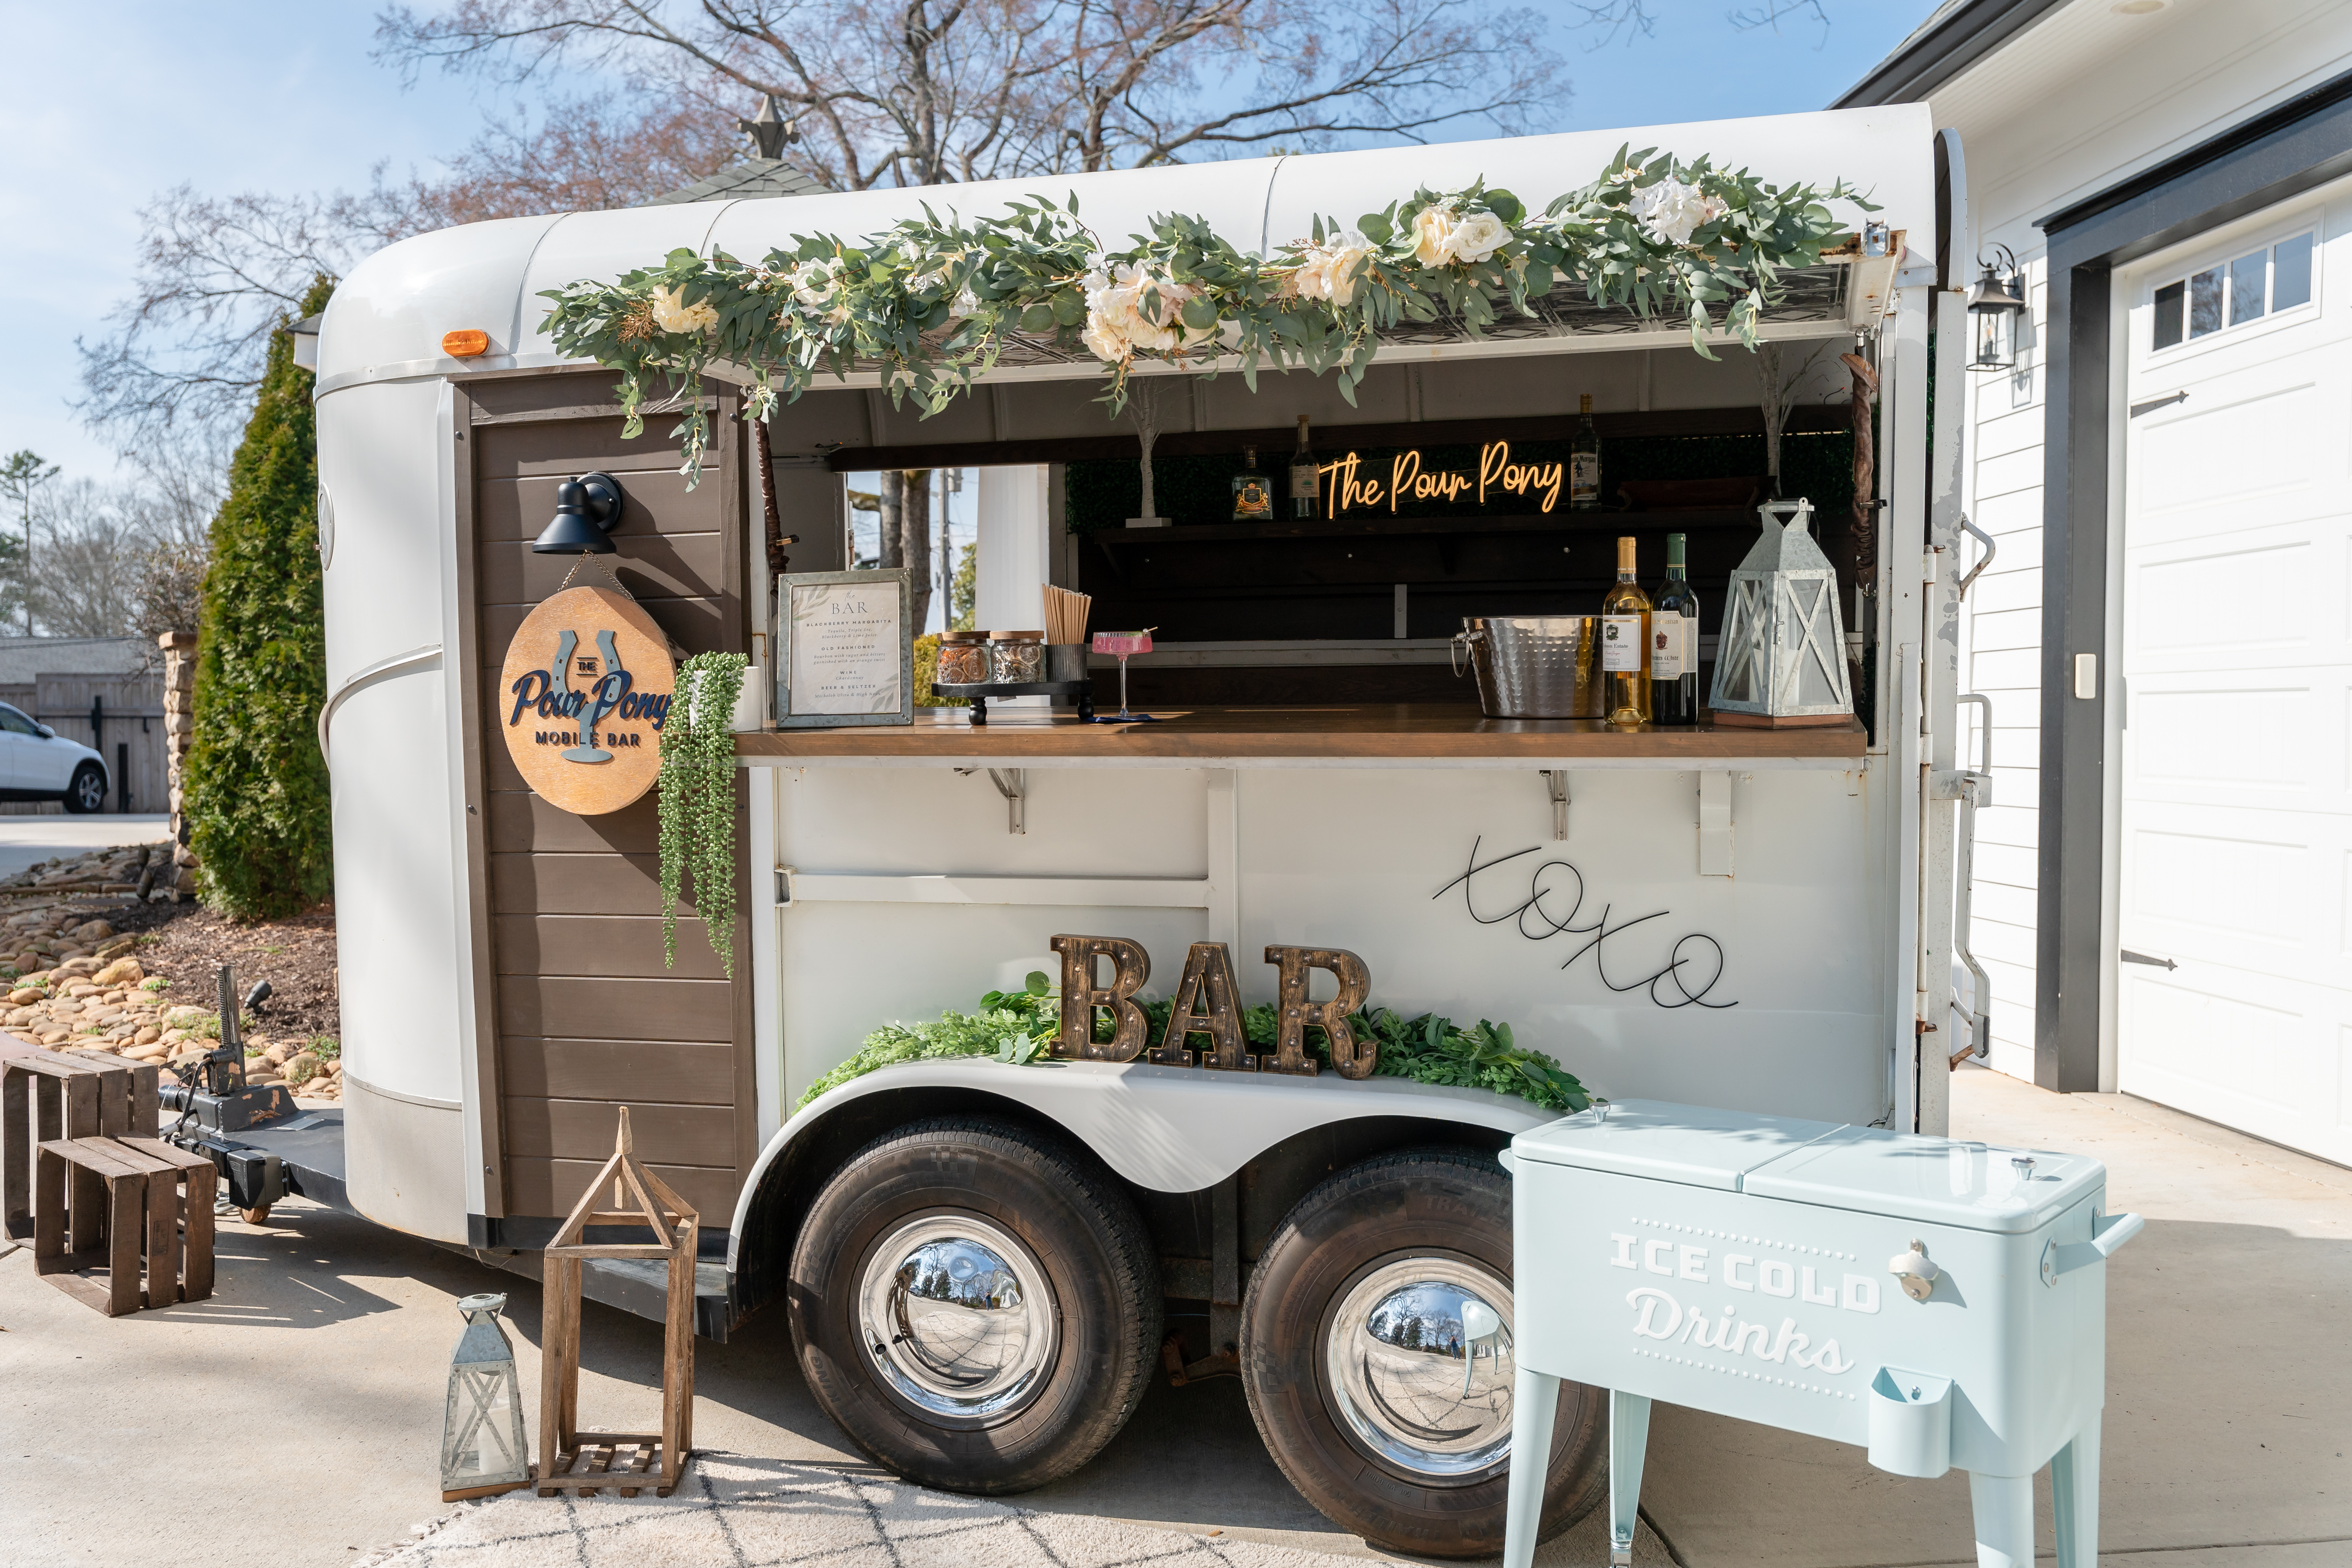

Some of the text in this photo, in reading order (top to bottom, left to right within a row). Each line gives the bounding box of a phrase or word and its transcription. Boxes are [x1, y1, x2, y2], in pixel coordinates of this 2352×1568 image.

[1319, 441, 1563, 520] The Pour Pony
[831, 602, 868, 615] BAR
[843, 590, 855, 601] the
[577, 661, 596, 671] THE
[510, 670, 673, 731] Pour Pony
[535, 731, 640, 746] MOBILE BAR
[1049, 933, 1381, 1080] BAR
[1611, 1232, 1881, 1314] ICE COLD
[1625, 1287, 1855, 1375] Drinks
[809, 1355, 841, 1403] KING
[1000, 1422, 1023, 1438] SERVICE
[1301, 1458, 1347, 1504] KING
[1347, 1502, 1439, 1541] TRAILER
